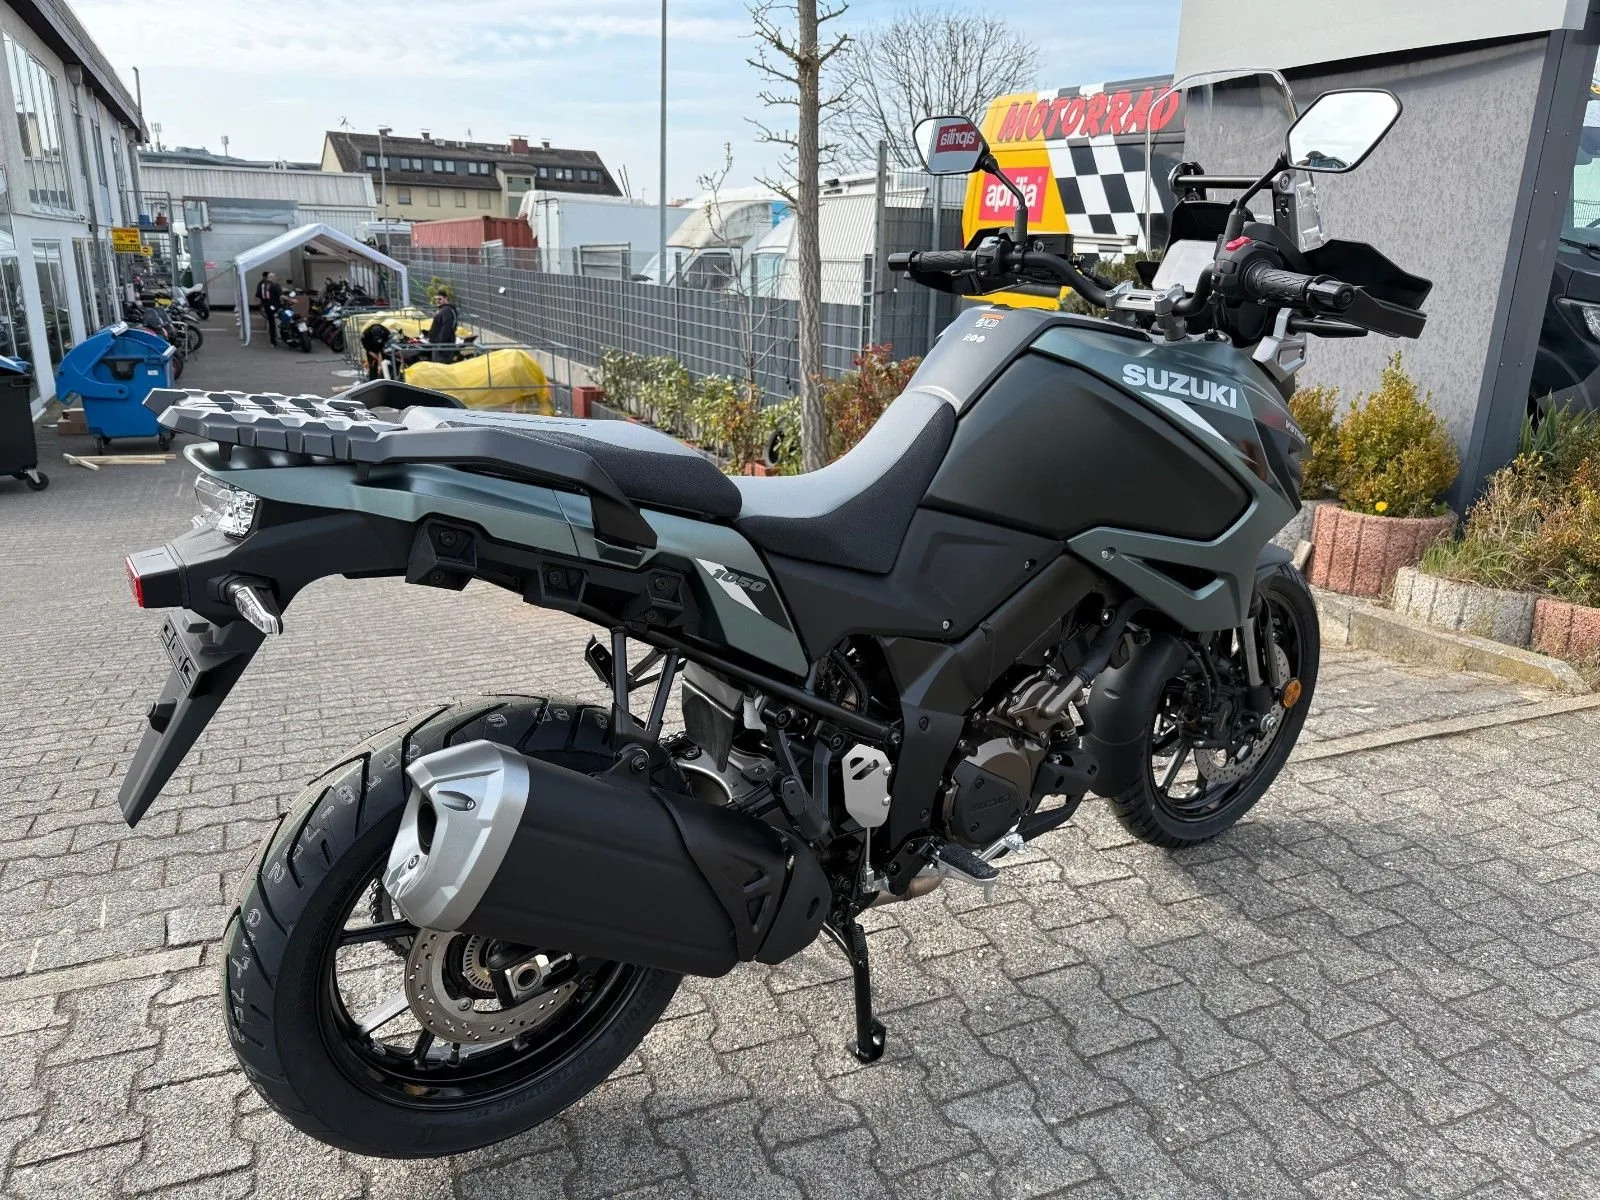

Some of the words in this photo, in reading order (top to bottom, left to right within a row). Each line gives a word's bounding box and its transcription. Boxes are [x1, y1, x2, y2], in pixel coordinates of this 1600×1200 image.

[997, 86, 1180, 142] MOTORRAD
[1122, 363, 1237, 409] SUZUKI
[713, 568, 767, 592] 1050
